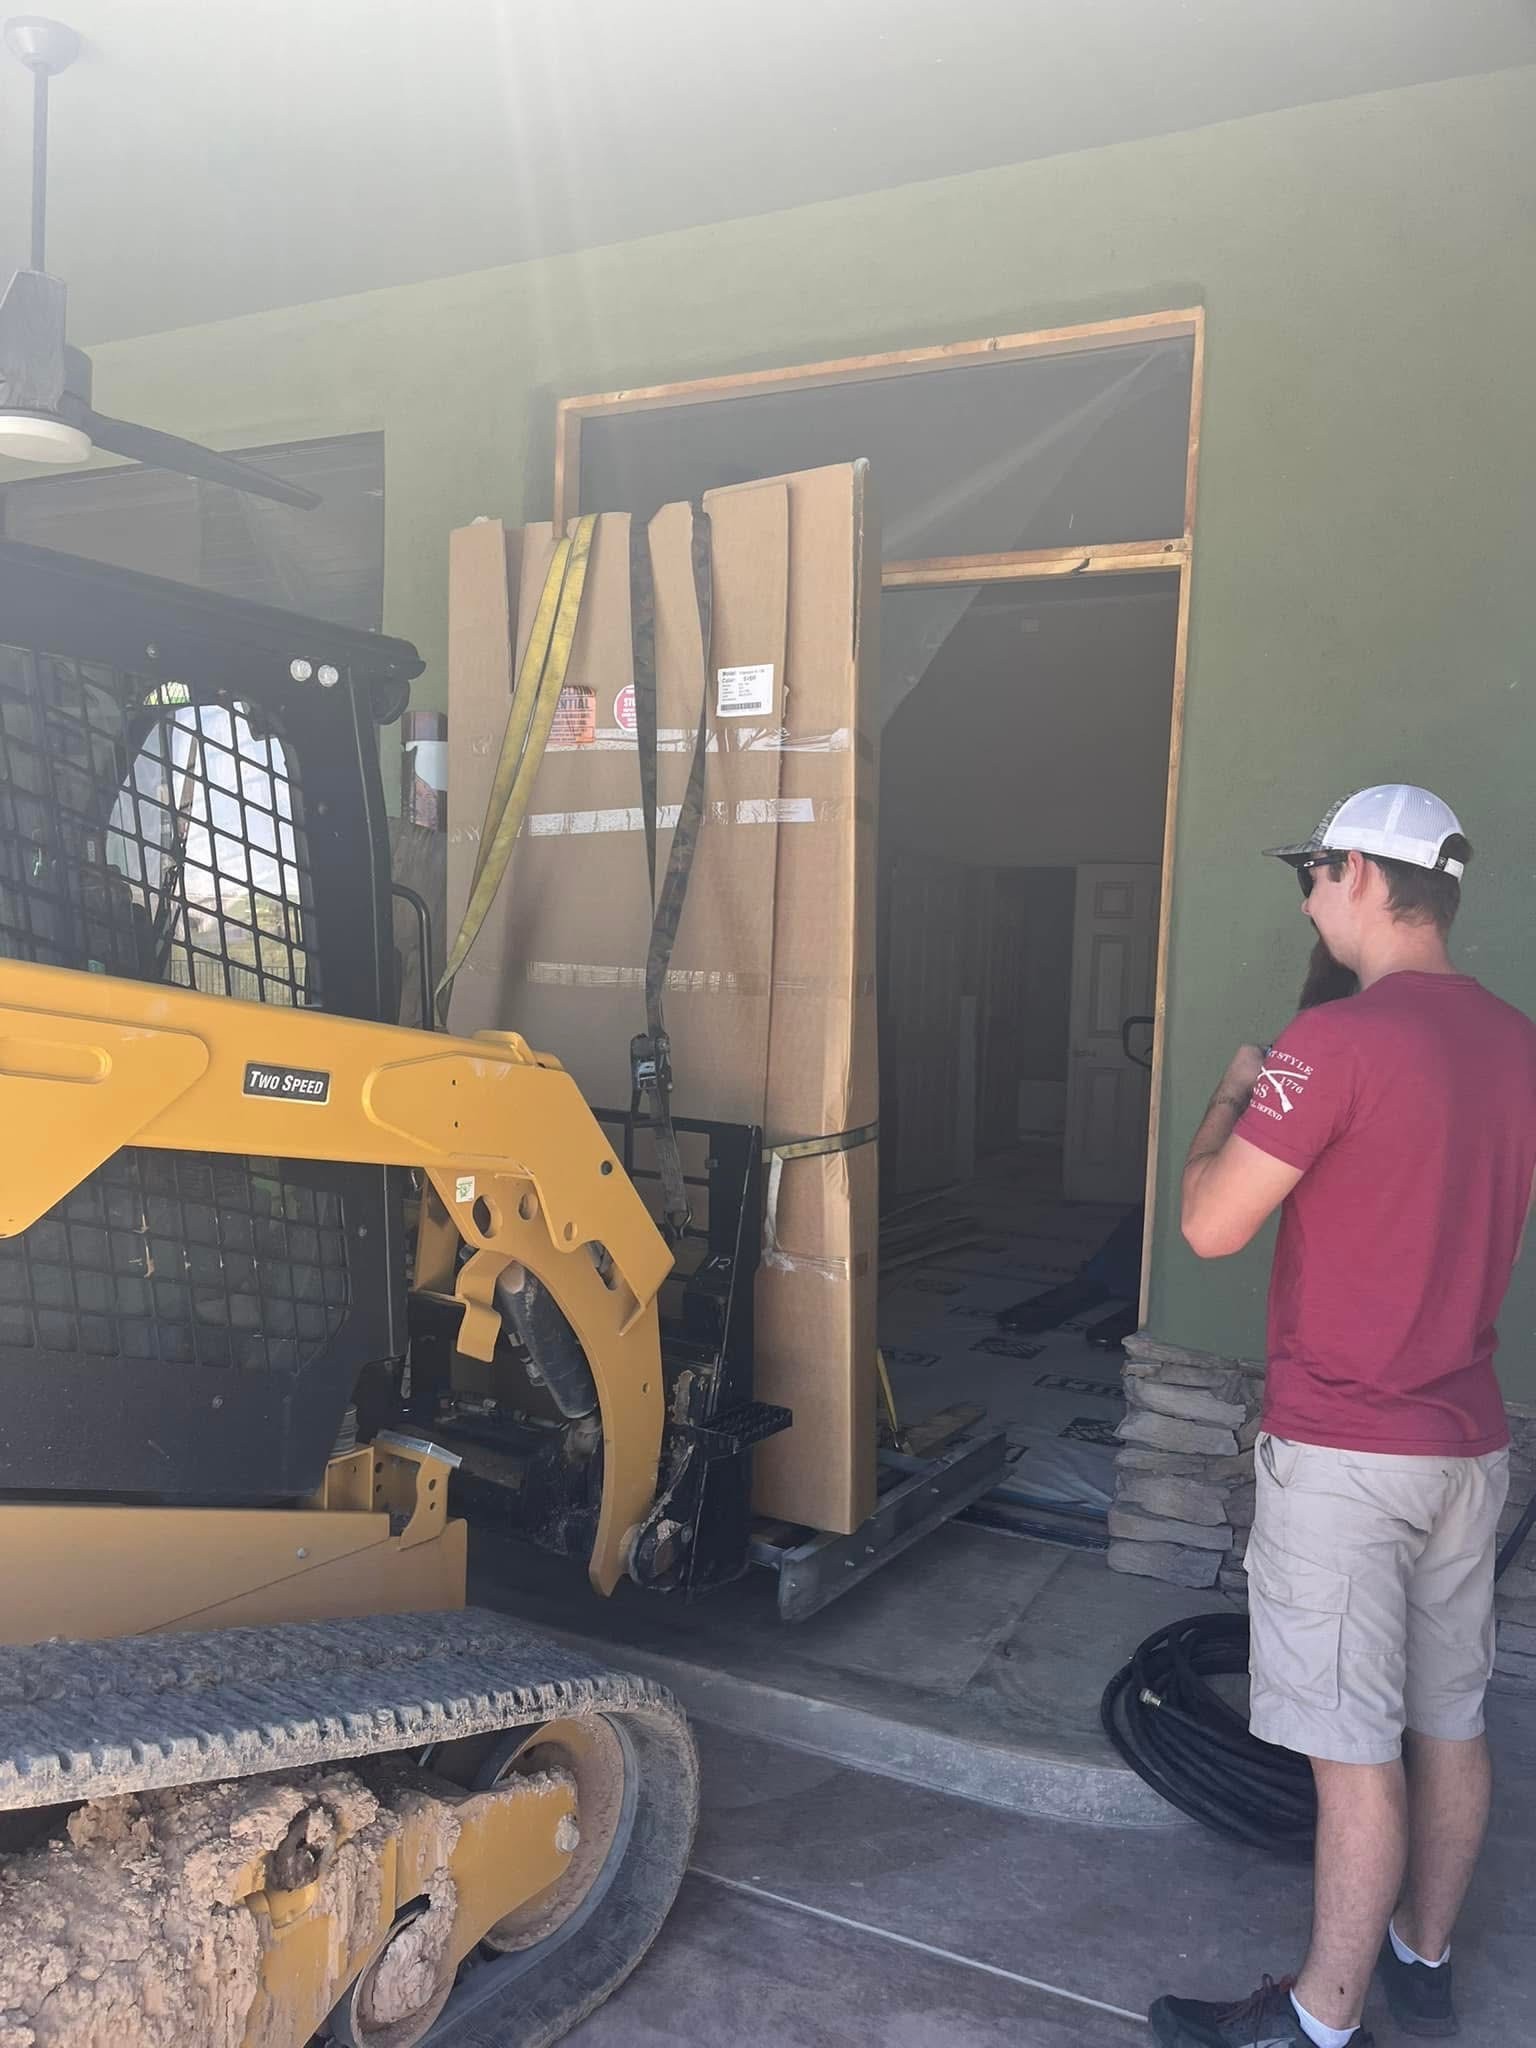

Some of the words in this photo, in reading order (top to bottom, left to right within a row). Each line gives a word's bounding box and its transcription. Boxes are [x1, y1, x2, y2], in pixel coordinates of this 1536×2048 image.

[1276, 1051, 1314, 1076] STYLE
[250, 1070, 281, 1090] TWO
[281, 1074, 324, 1095] SPEED
[1280, 1076, 1304, 1095] 1776
